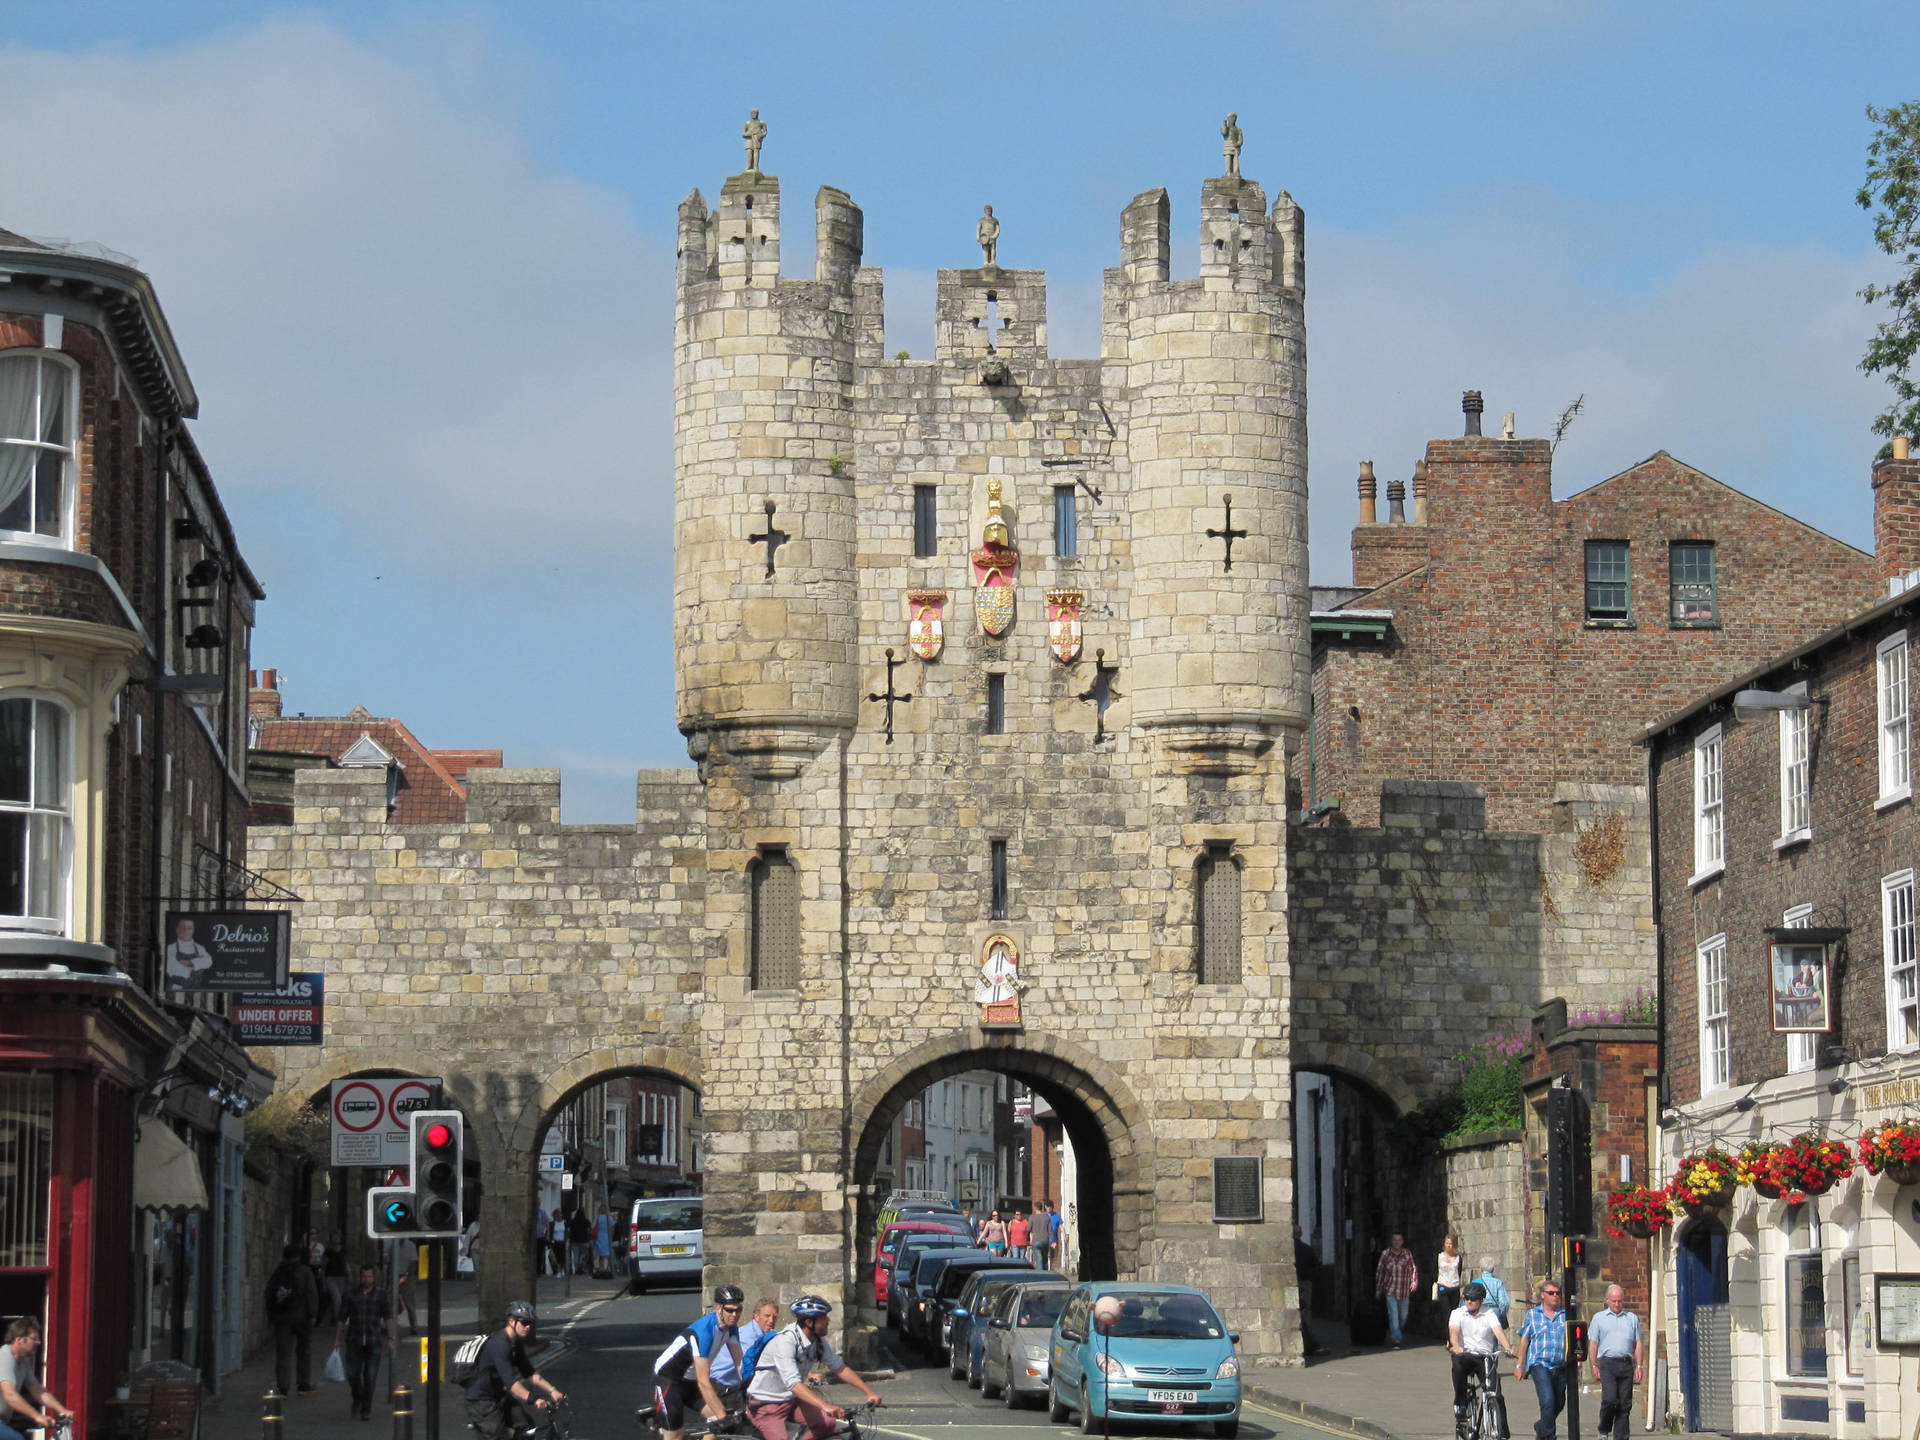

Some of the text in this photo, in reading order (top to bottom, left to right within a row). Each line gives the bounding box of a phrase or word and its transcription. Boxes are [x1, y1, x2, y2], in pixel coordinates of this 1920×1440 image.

[213, 924, 270, 942] Delrio's
[239, 1009, 313, 1022] UNDER OFFER
[241, 1024, 272, 1034] 01904
[1882, 1079, 1913, 1104] PUNCH
[553, 1158, 561, 1168] P
[1152, 1391, 1194, 1401] YF05 EAO
